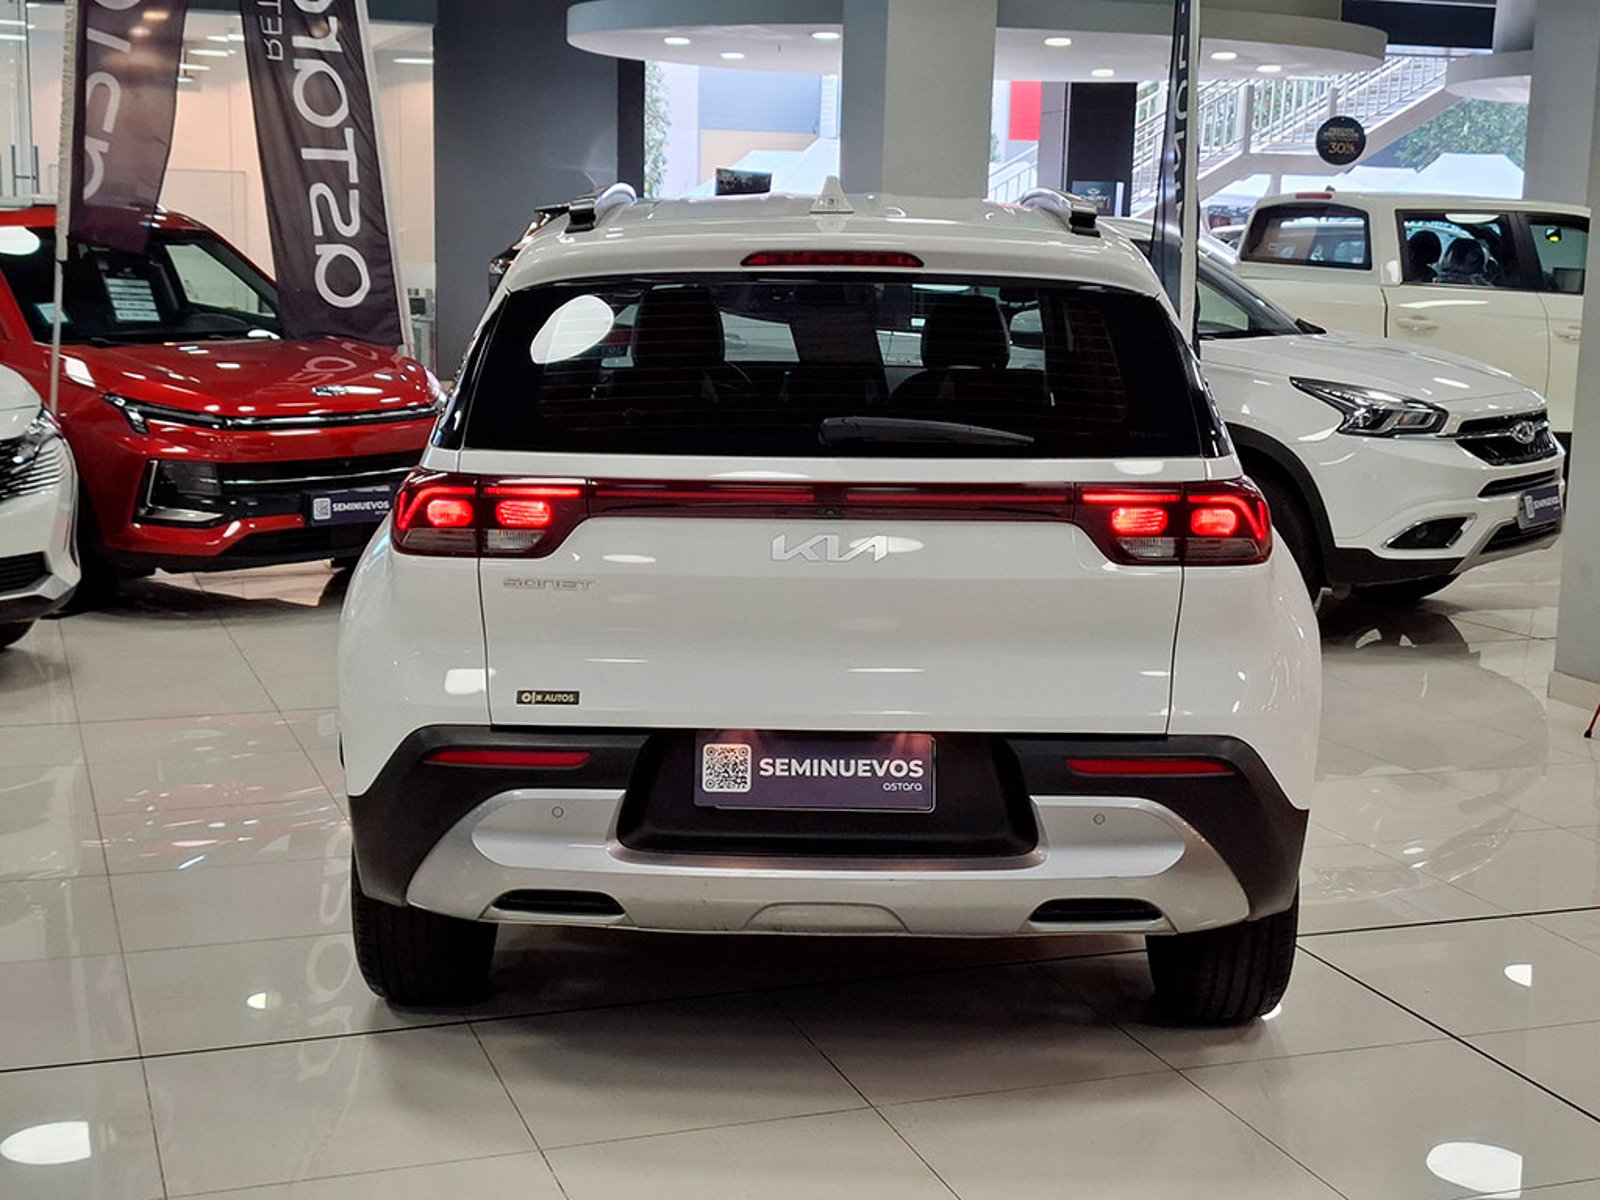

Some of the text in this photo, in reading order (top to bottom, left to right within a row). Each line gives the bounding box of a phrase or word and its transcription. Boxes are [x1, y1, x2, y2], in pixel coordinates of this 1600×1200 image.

[770, 533, 889, 563] KIA
[503, 576, 597, 592] SONET
[543, 692, 575, 703] AUTOS
[758, 757, 925, 779] SEMINUEVOS
